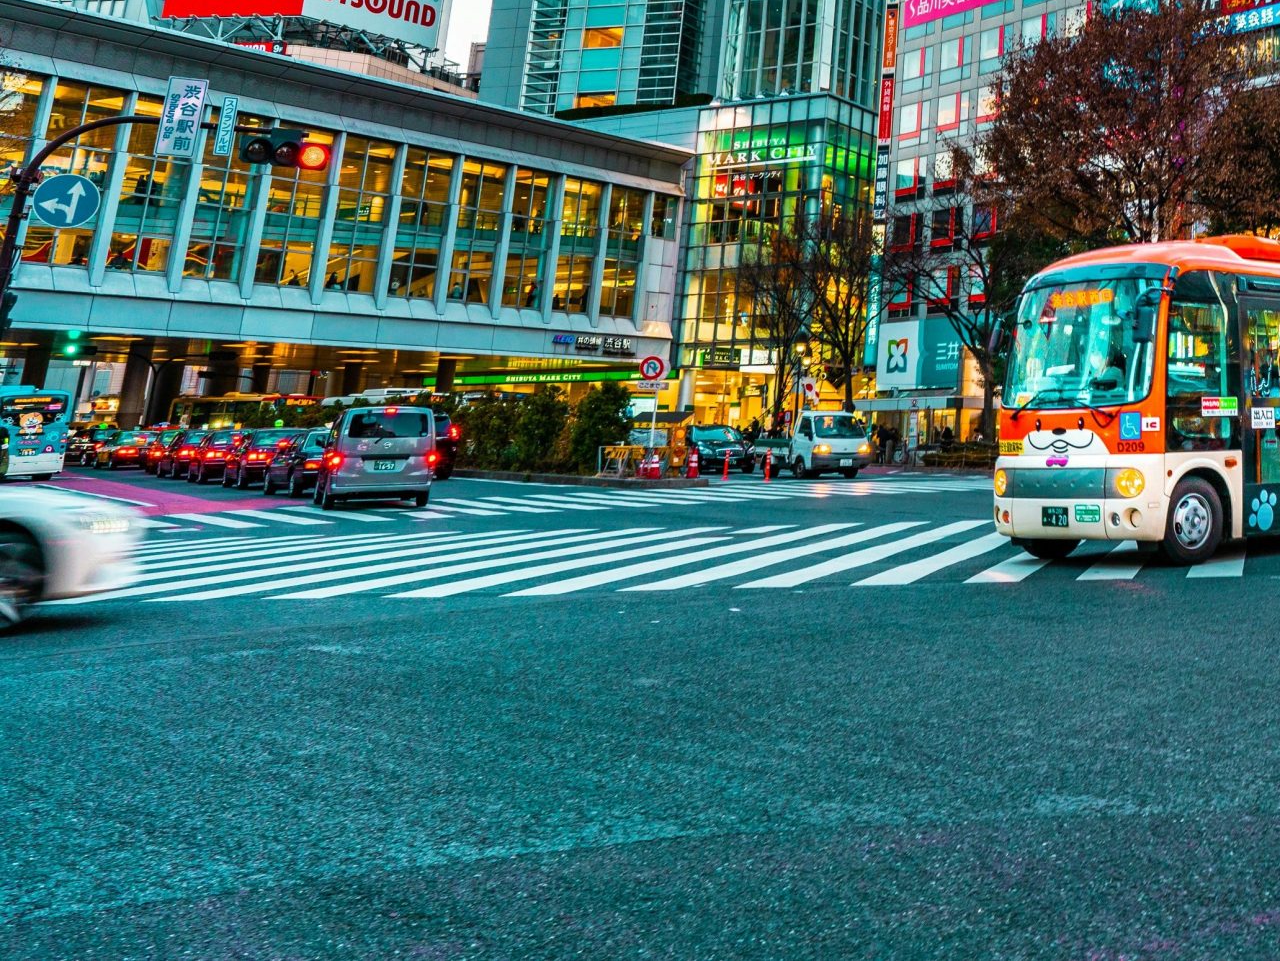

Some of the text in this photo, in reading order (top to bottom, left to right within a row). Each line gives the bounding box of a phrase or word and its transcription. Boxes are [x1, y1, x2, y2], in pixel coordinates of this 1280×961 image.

[162, 93, 180, 141] Shibuya Sta.
[173, 85, 202, 151] 渋谷駅前
[218, 100, 235, 152] スクランブル式
[707, 144, 817, 165] MARK CITY
[734, 138, 786, 150] SHIBUYA
[875, 154, 888, 207] 加藤眼科
[1253, 410, 1272, 420] 出入口
[1117, 442, 1145, 452] D209
